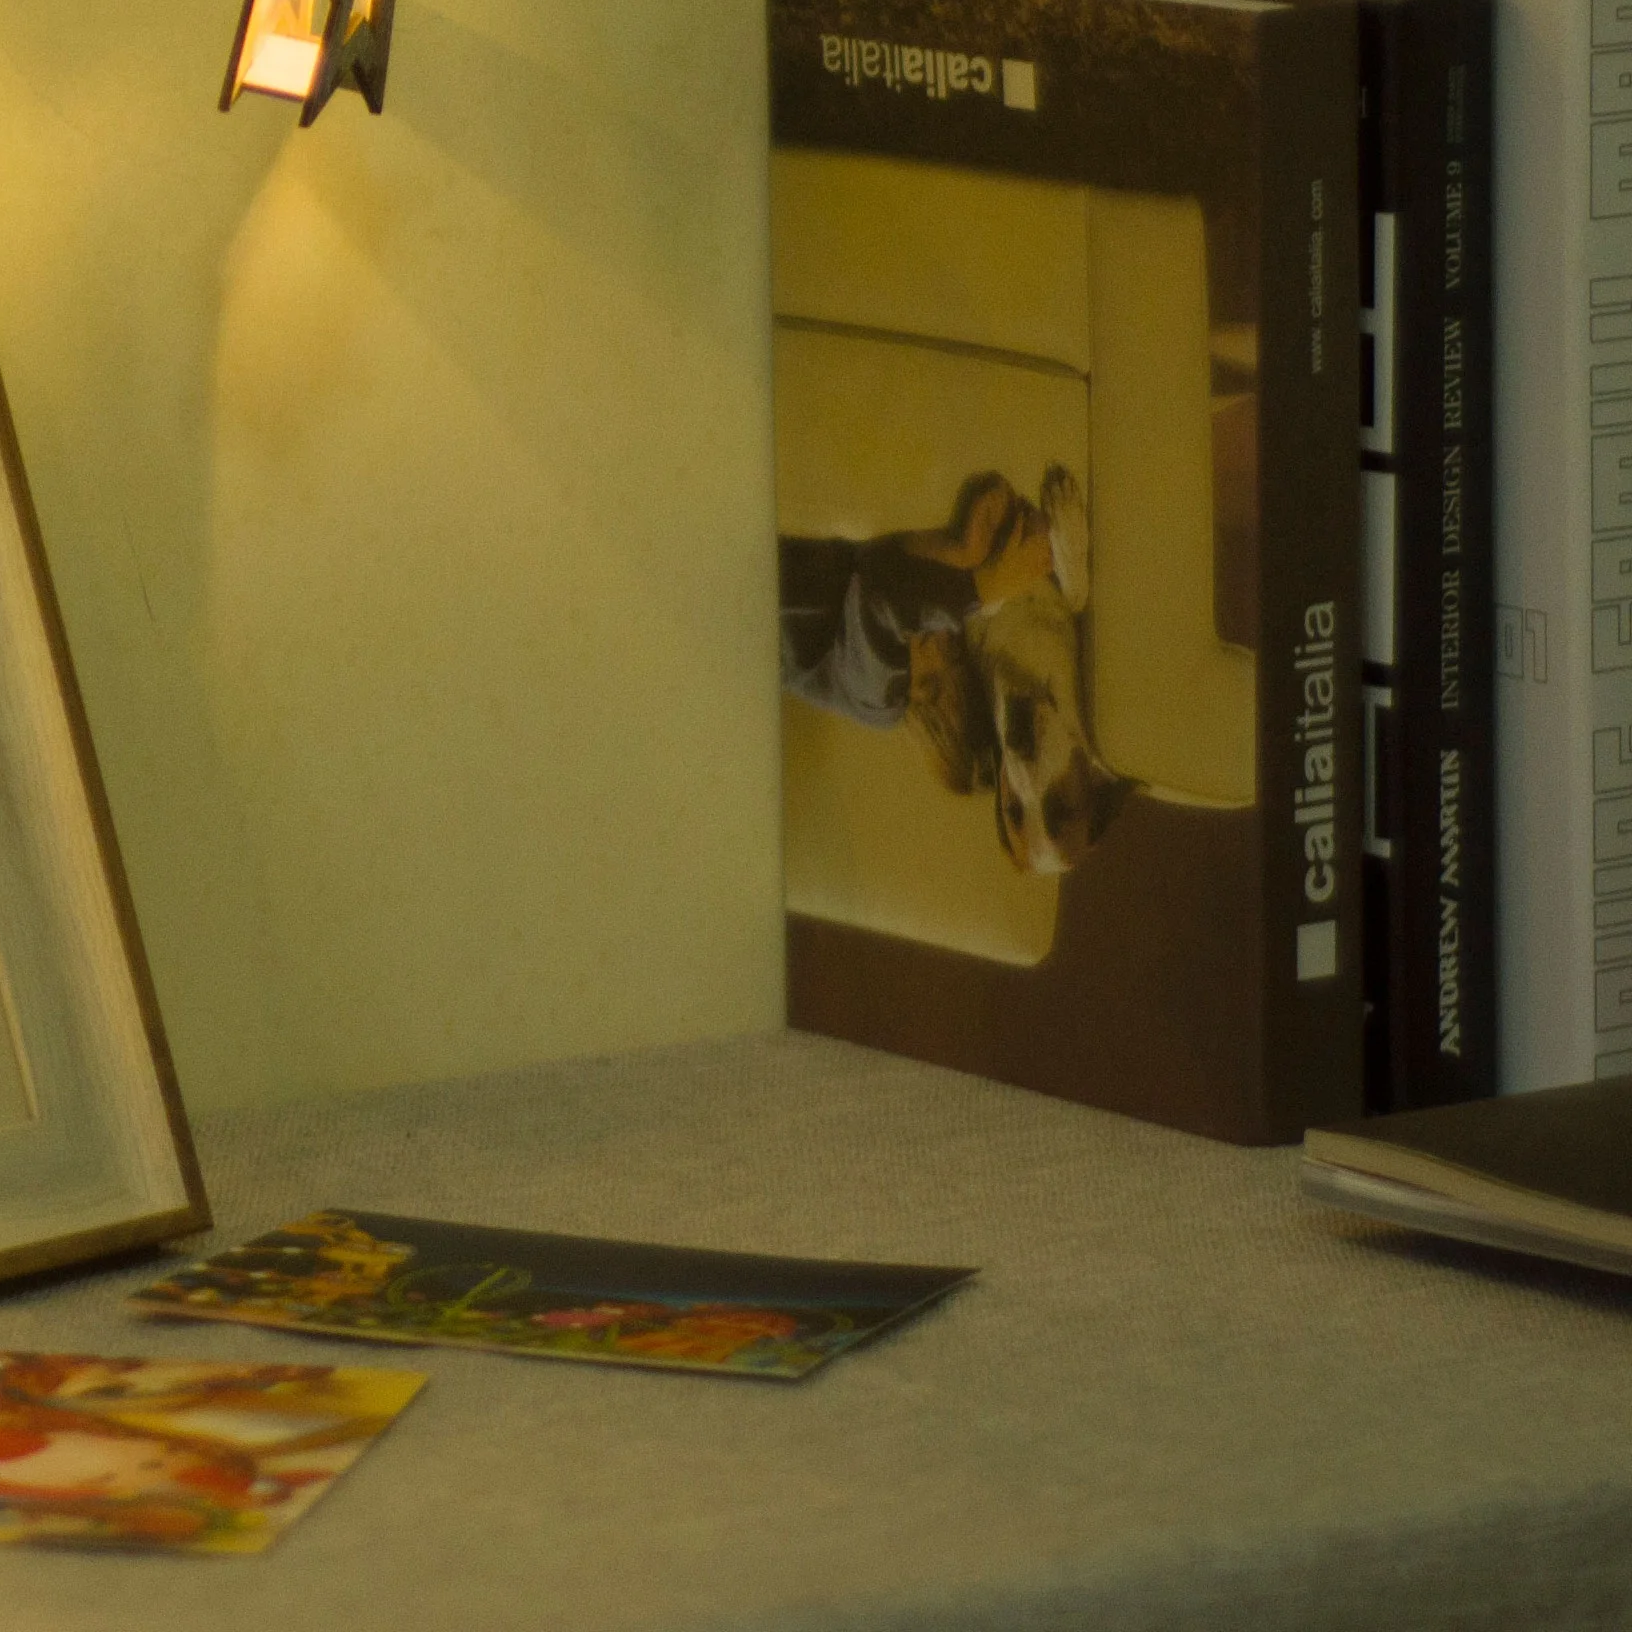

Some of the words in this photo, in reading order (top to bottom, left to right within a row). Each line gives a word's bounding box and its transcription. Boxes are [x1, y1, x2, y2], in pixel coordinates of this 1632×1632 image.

[820, 33, 993, 99] caliaitalia
[1446, 160, 1463, 176] 9
[1445, 182, 1463, 290] VOLUME
[1443, 316, 1463, 431] REVIEW
[1441, 444, 1462, 555] DESIGN
[1440, 569, 1461, 710] INTERIOR
[1294, 600, 1336, 903] caliaitalia
[1439, 748, 1461, 887] MARTIN
[1438, 895, 1461, 1058] ANDREW
